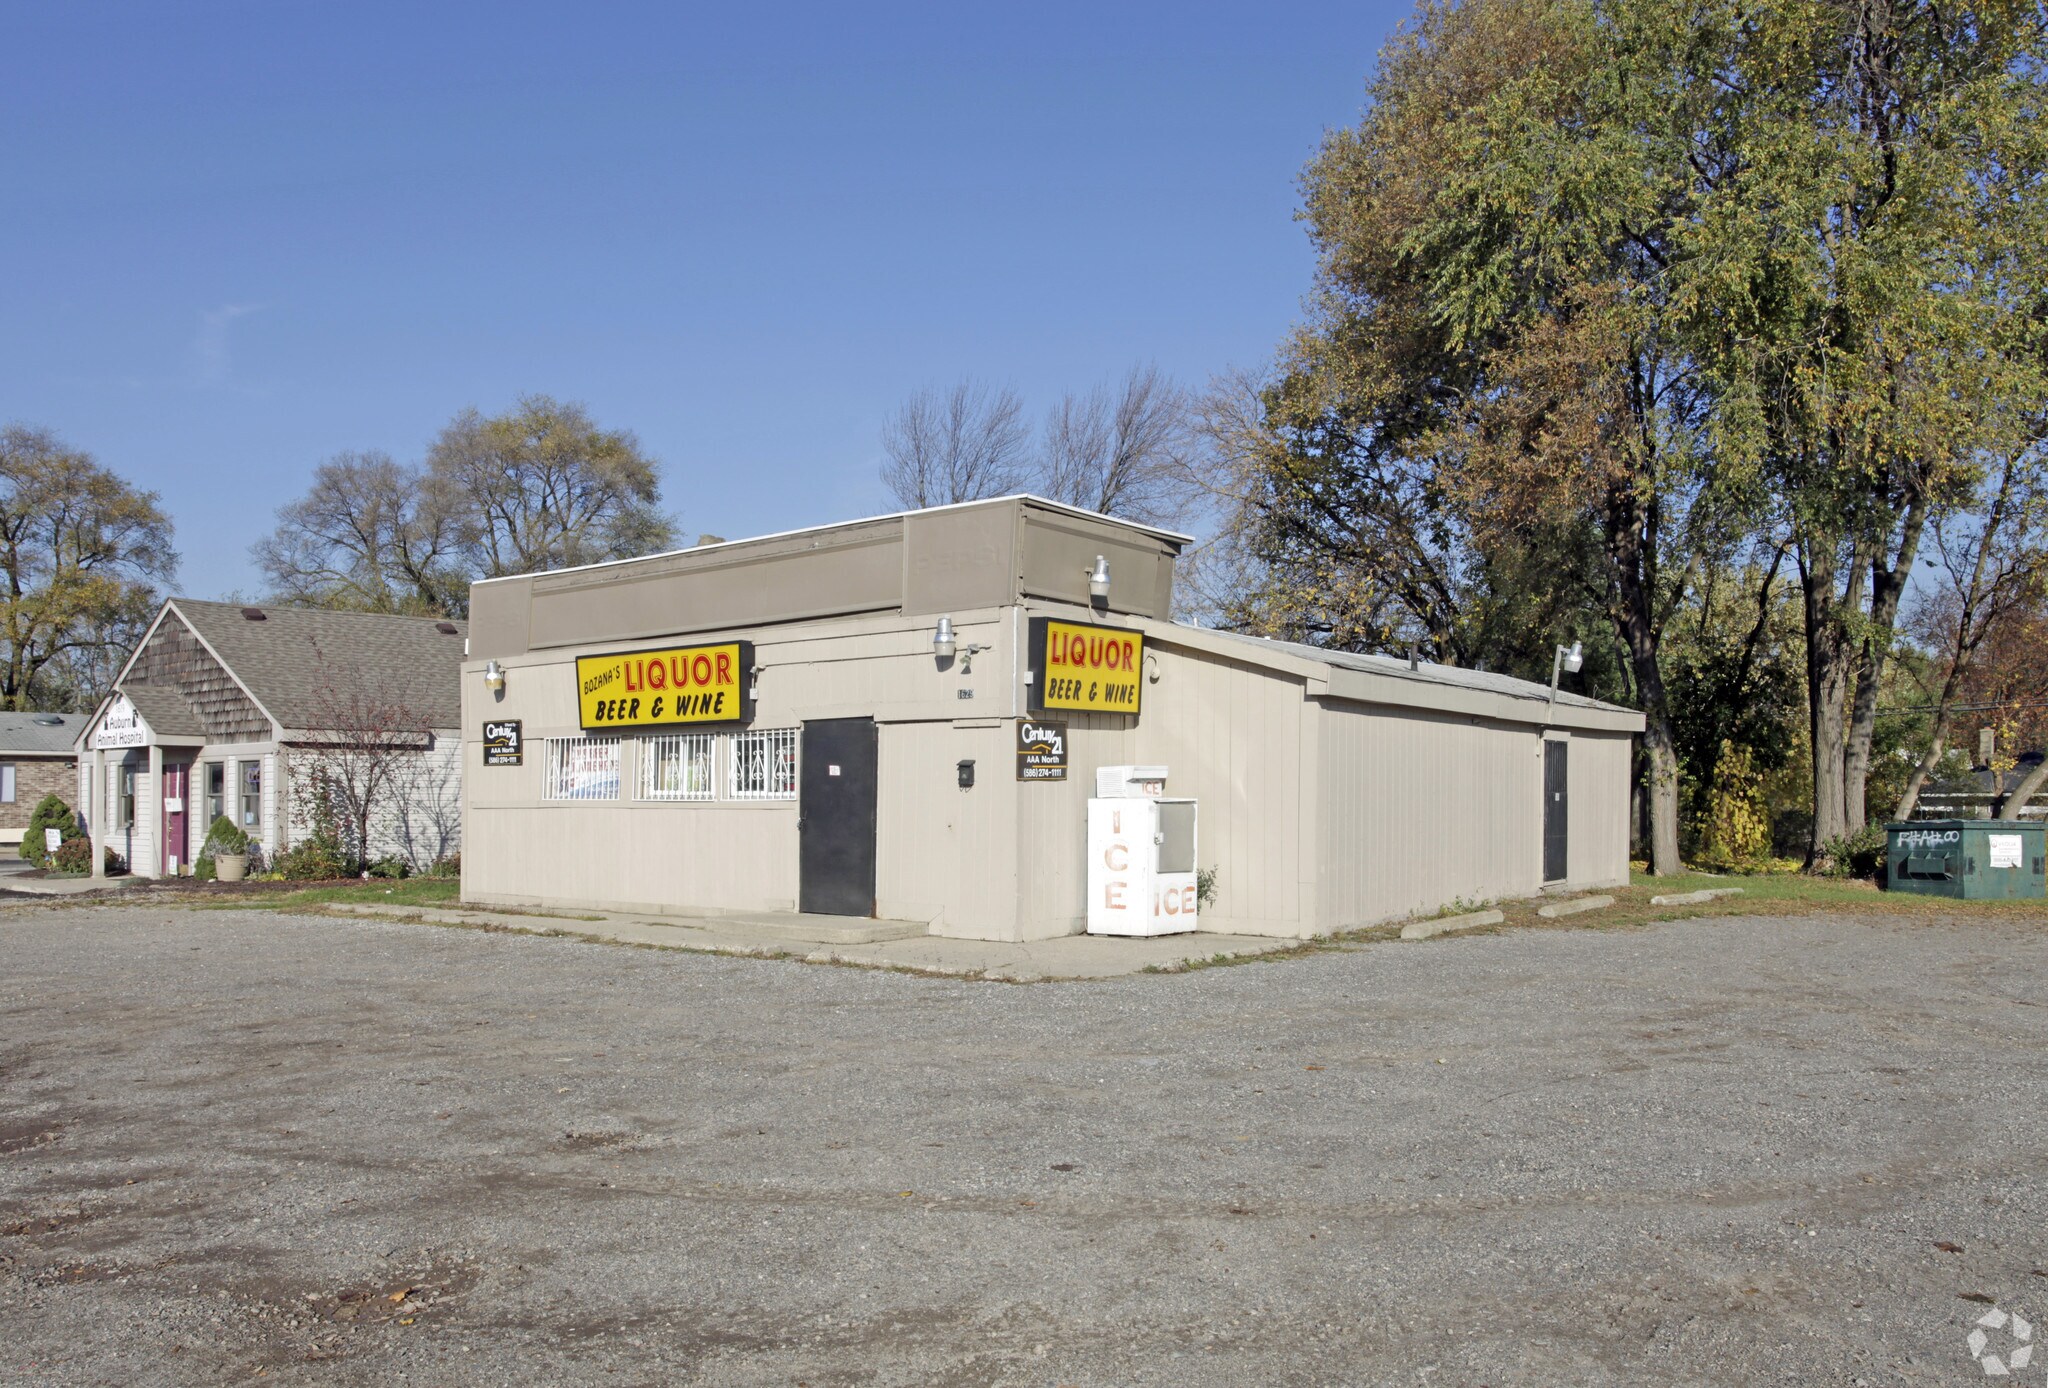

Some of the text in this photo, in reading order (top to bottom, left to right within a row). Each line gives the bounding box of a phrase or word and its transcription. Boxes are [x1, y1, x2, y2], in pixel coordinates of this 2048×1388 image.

[1051, 631, 1134, 672] LIQUOR
[584, 652, 733, 695] BOZANA'S LIQUOR
[1048, 678, 1135, 704] BEER & WINE
[595, 691, 725, 721] BEER & WINE
[110, 717, 131, 729] Auburn
[486, 723, 512, 739] Century
[98, 731, 143, 745] Animal Hospital
[1022, 723, 1063, 754] Century 21
[1041, 755, 1059, 763] North
[1141, 782, 1160, 796] ICE
[1104, 810, 1129, 910] ICE
[1154, 885, 1196, 917] ICE
